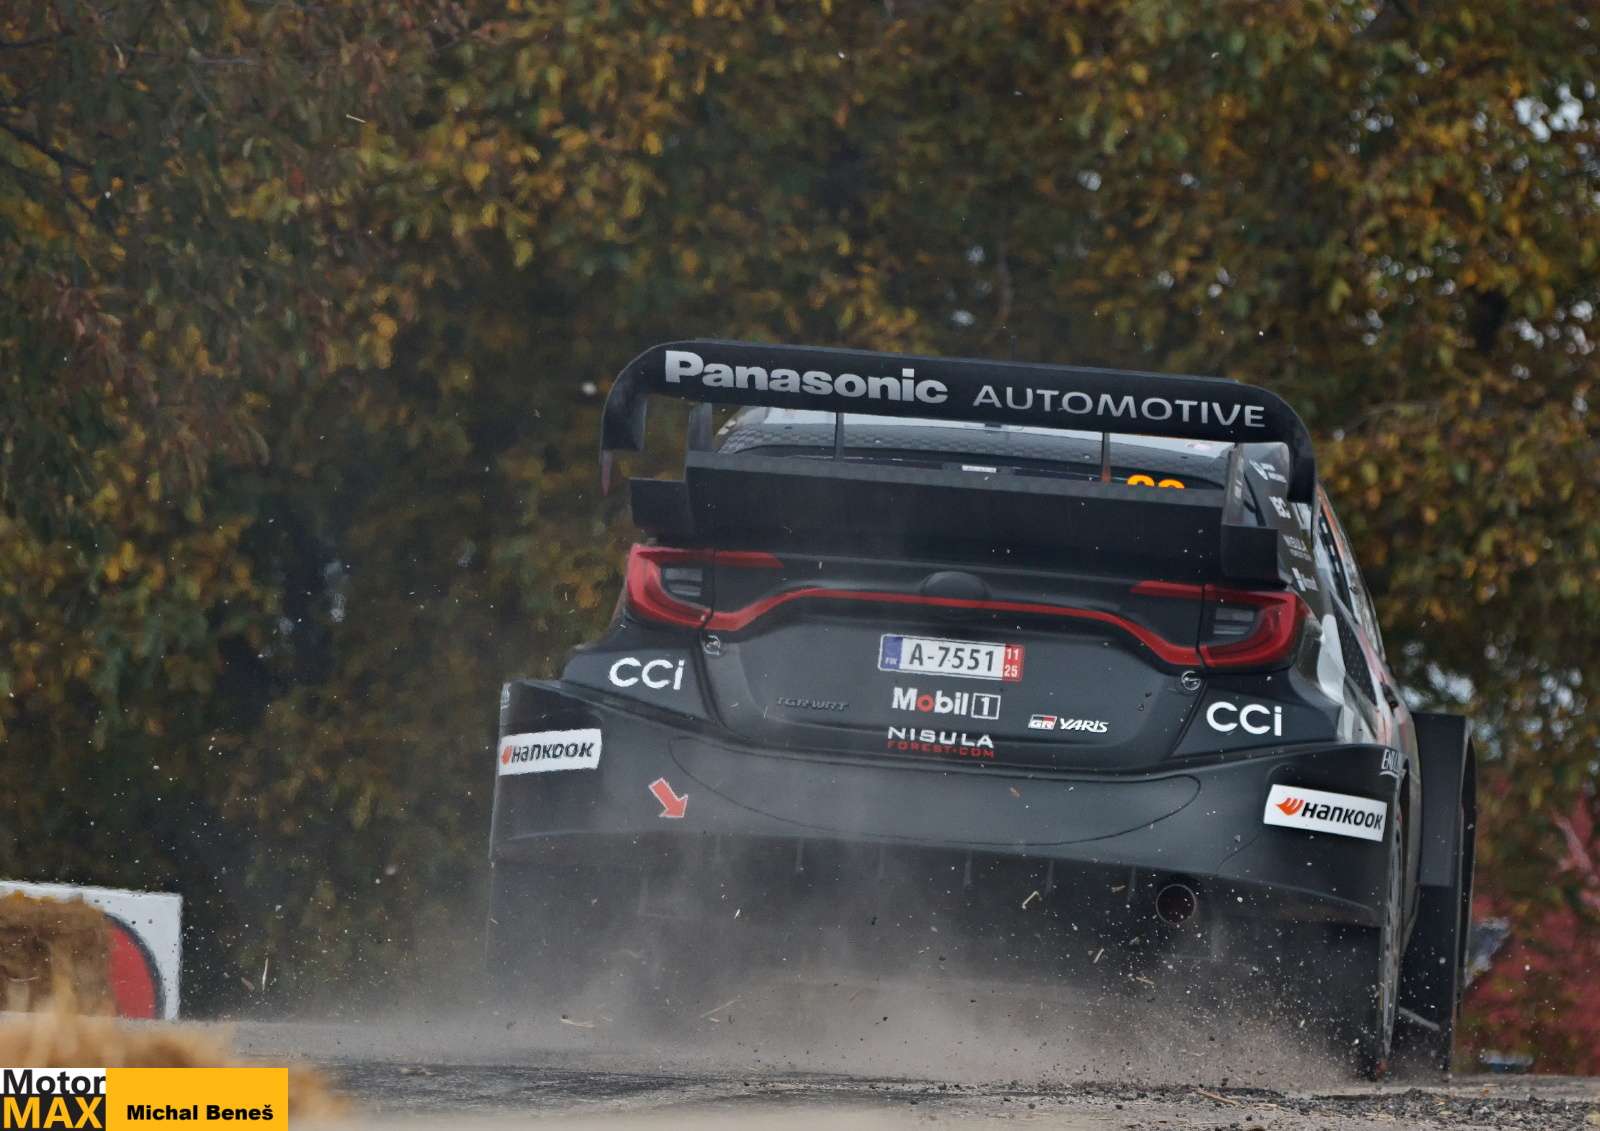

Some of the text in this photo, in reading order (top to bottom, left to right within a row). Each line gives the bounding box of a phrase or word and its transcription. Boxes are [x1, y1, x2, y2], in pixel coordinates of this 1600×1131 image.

[665, 350, 1265, 427] Panasonic AUTOMOTIVE
[908, 643, 994, 672] A-7551
[1006, 648, 1020, 661] 11
[1004, 664, 1019, 678] 25
[891, 686, 969, 716] Mobil
[887, 726, 994, 748] NISULA
